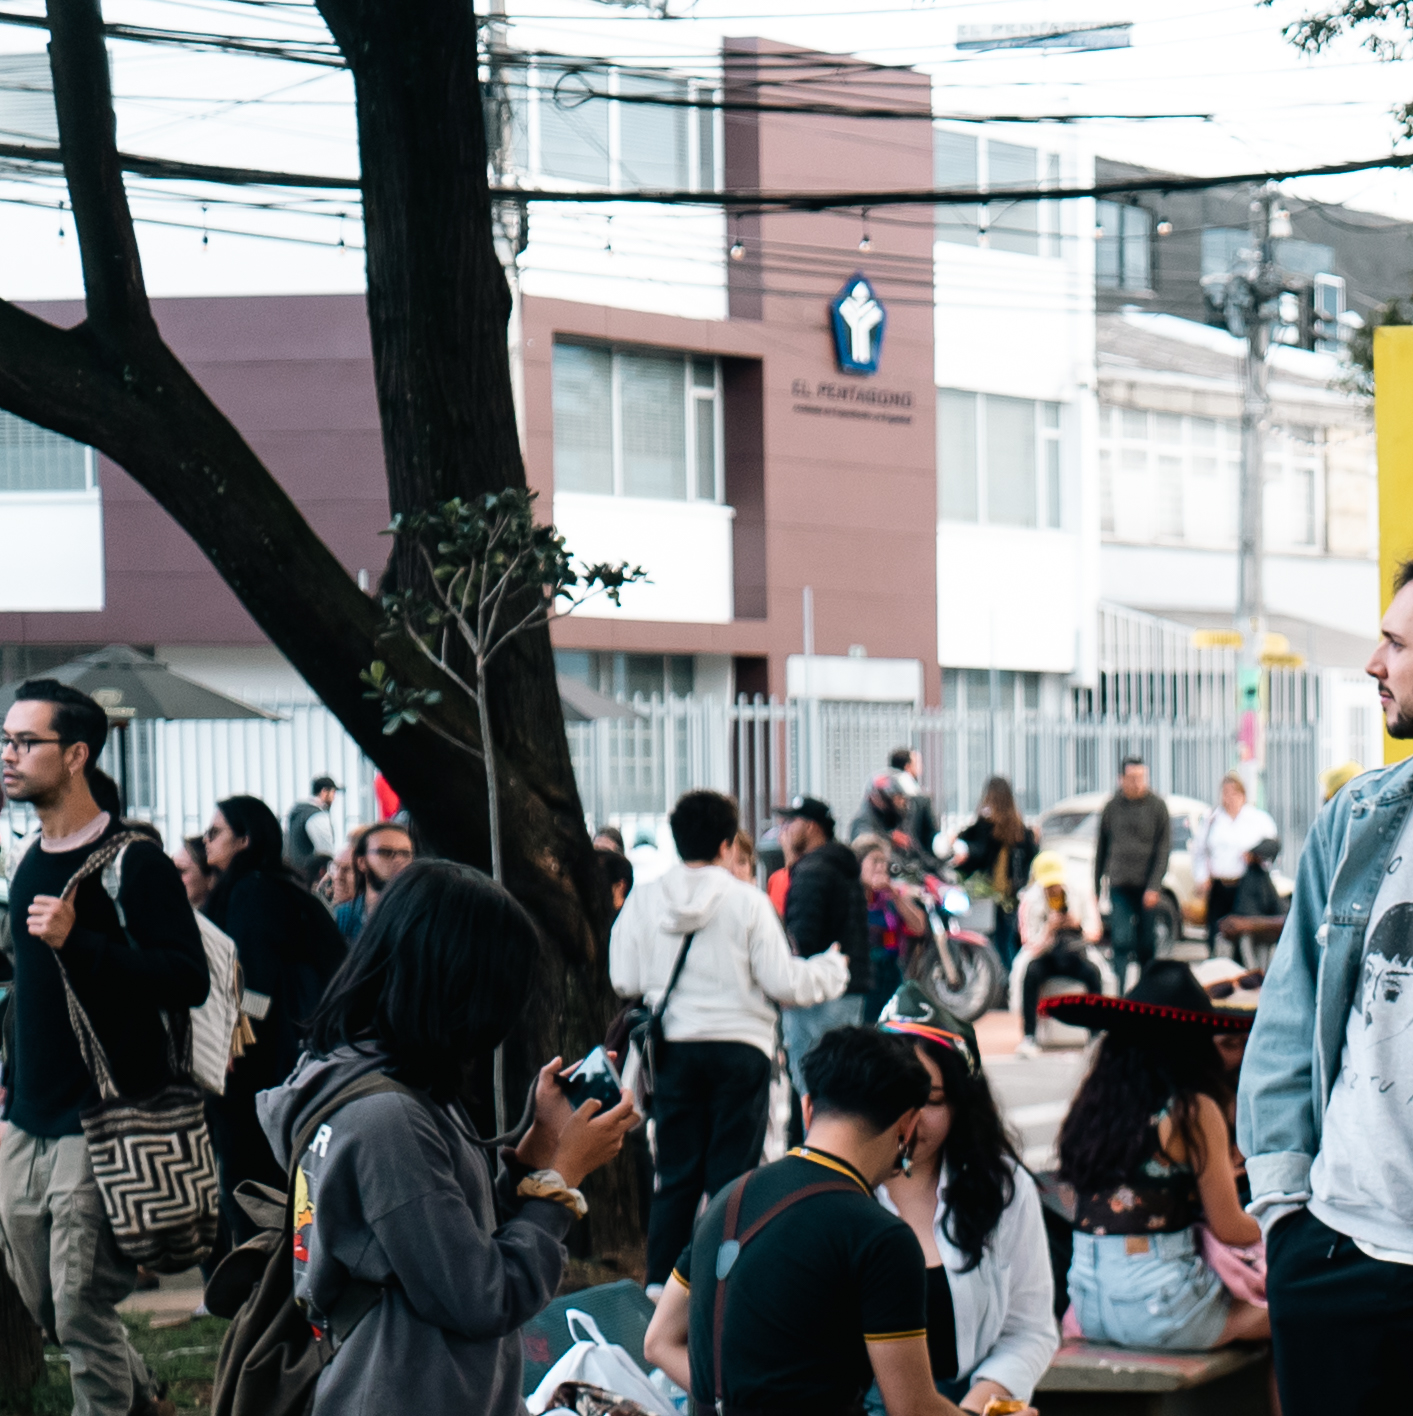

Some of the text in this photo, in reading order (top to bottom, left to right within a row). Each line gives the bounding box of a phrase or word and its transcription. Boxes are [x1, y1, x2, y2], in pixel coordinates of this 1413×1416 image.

[791, 379, 913, 407] EL PENTAGONO
[1386, 855, 1402, 875] O
